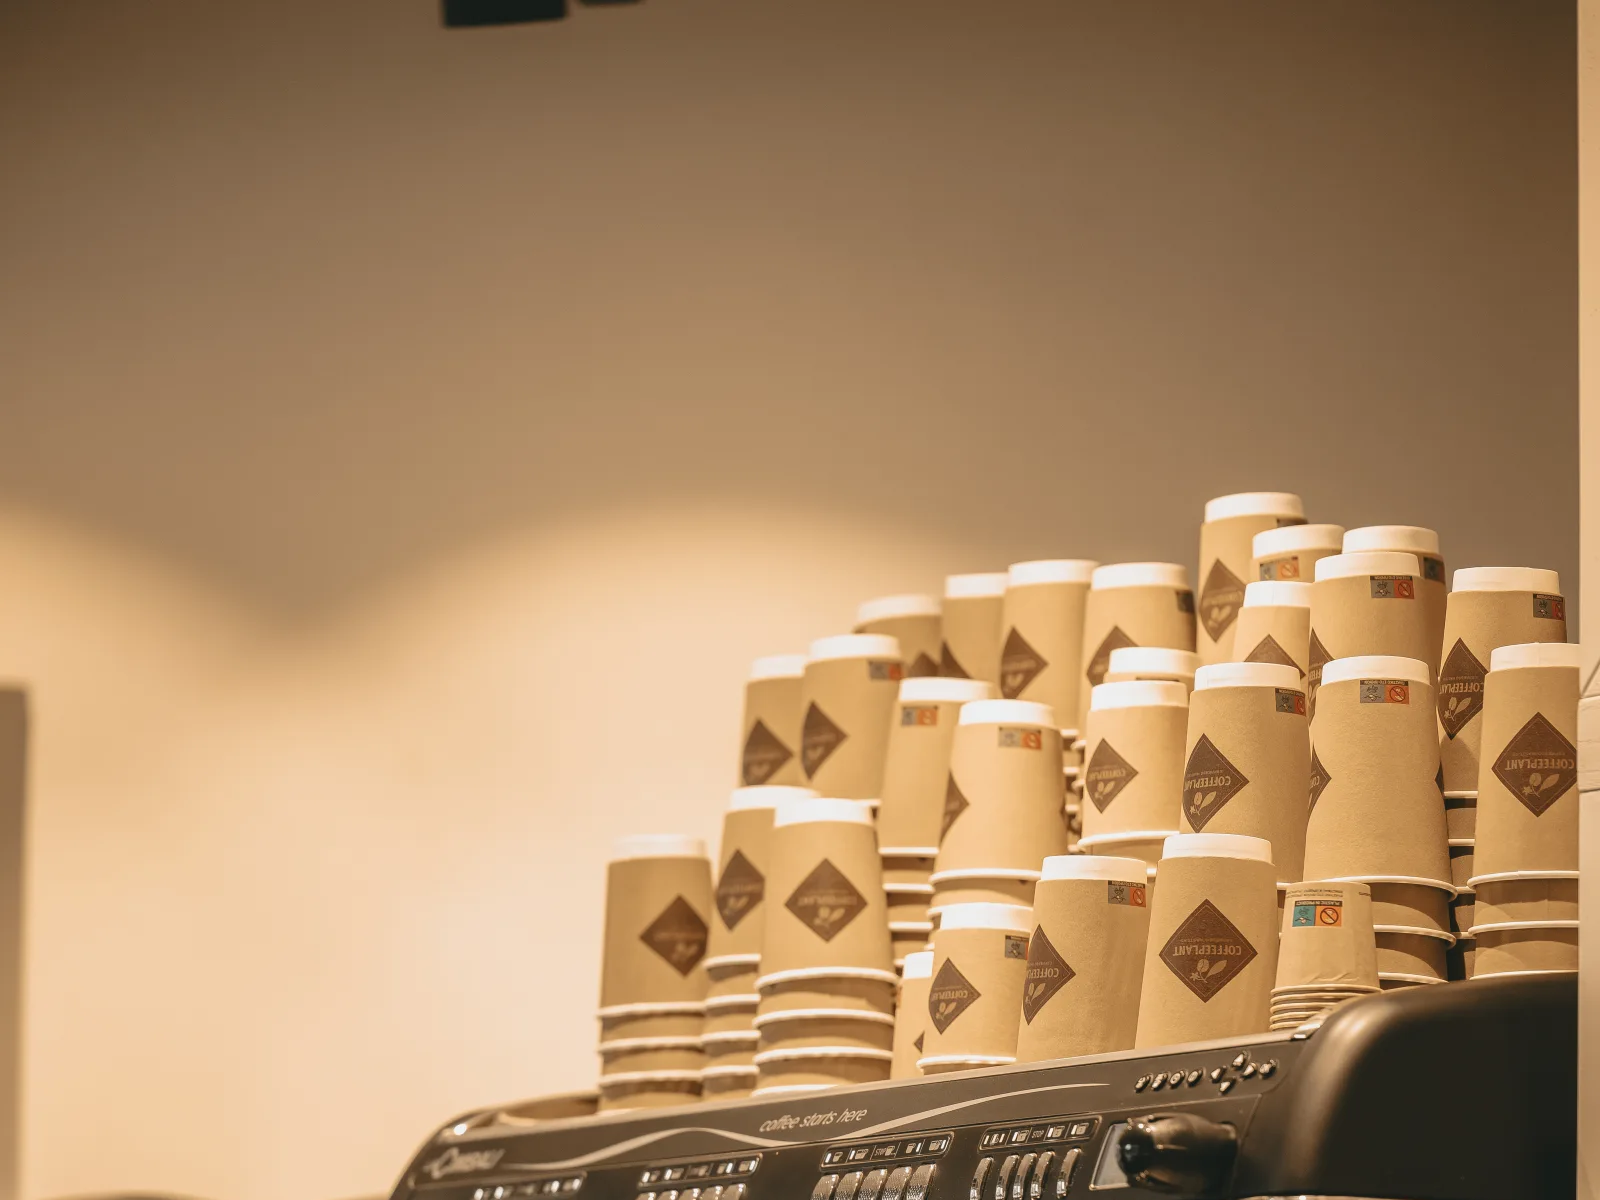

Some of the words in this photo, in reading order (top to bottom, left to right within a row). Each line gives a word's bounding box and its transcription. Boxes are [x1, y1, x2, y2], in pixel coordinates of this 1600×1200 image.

[1504, 758, 1575, 771] COFFEEPLANT
[1172, 944, 1242, 957] COFFEEPLANT
[759, 1114, 801, 1132] coffee
[800, 1110, 838, 1128] starts
[836, 1107, 868, 1123] here
